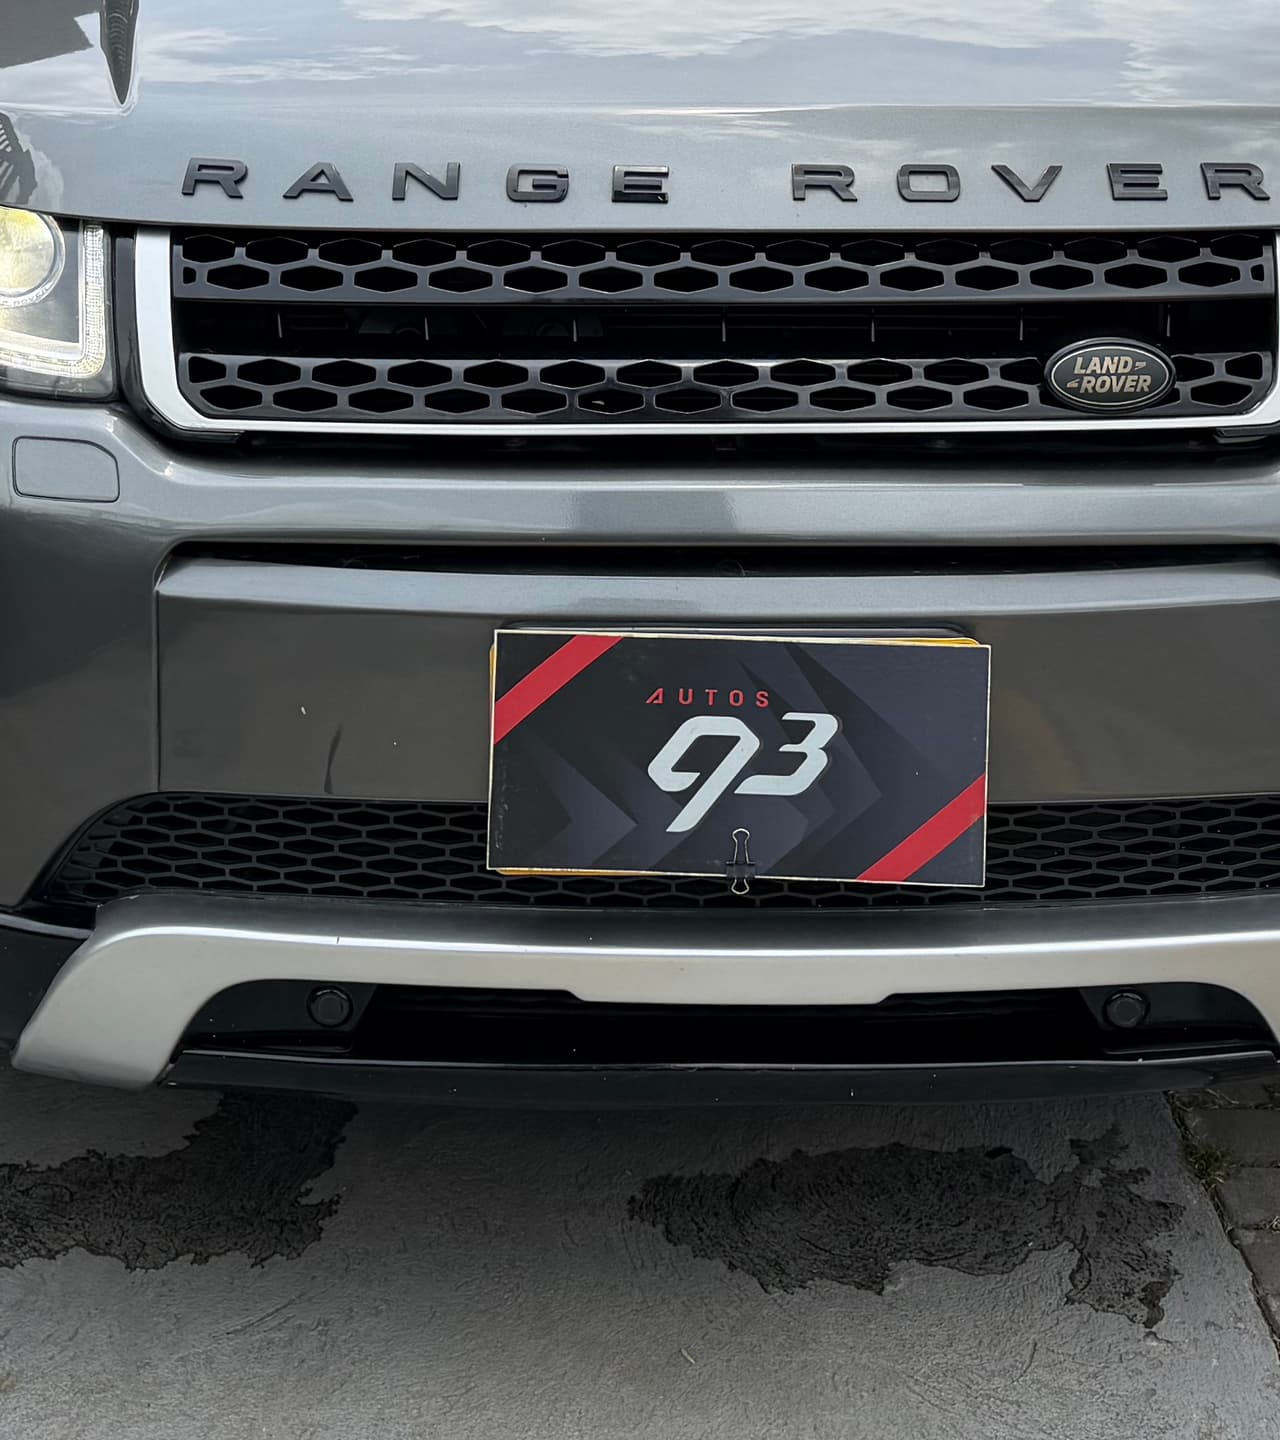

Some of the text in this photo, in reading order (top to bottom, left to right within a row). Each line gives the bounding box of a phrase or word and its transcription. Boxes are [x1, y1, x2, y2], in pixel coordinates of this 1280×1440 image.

[181, 157, 1271, 203] RANGE ROVER
[1074, 356, 1133, 375] LAND
[1079, 375, 1152, 394] ROVER
[645, 687, 770, 709] AUTOS
[647, 711, 840, 833] 93
